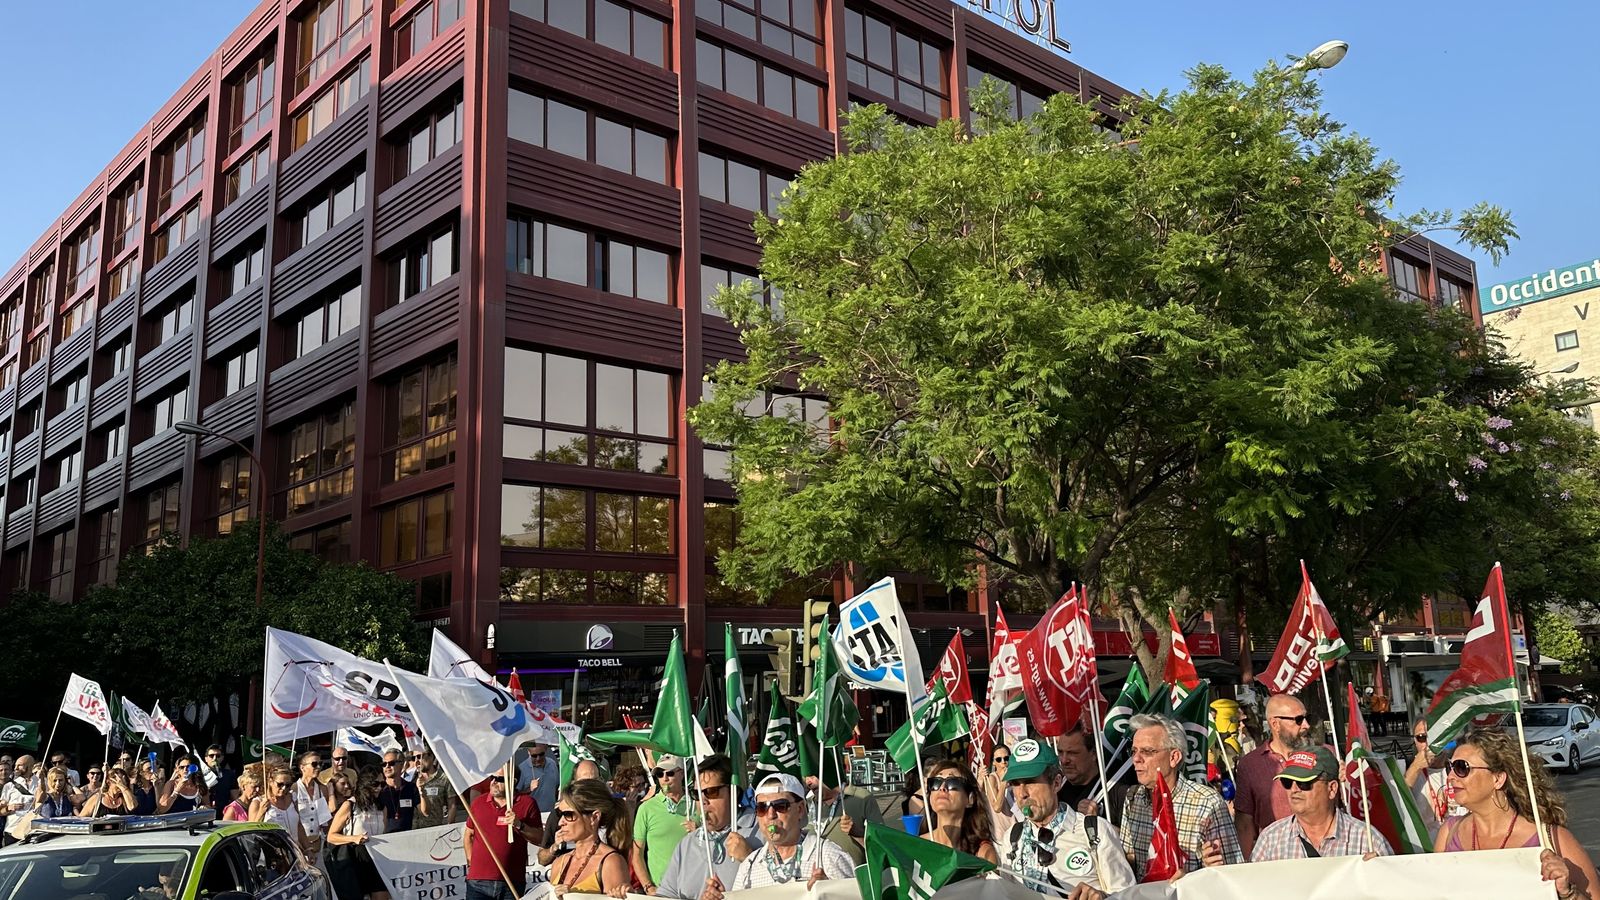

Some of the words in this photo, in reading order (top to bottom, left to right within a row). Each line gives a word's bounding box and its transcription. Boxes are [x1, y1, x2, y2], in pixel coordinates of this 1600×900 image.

[1491, 259, 1600, 306] Occident
[738, 628, 783, 645] TAC
[578, 659, 601, 667] TACO
[602, 658, 622, 667] BELL
[3, 731, 28, 740] CSIF
[764, 731, 802, 768] CSIF
[1071, 856, 1089, 866] CSIF
[417, 883, 458, 900] POR
